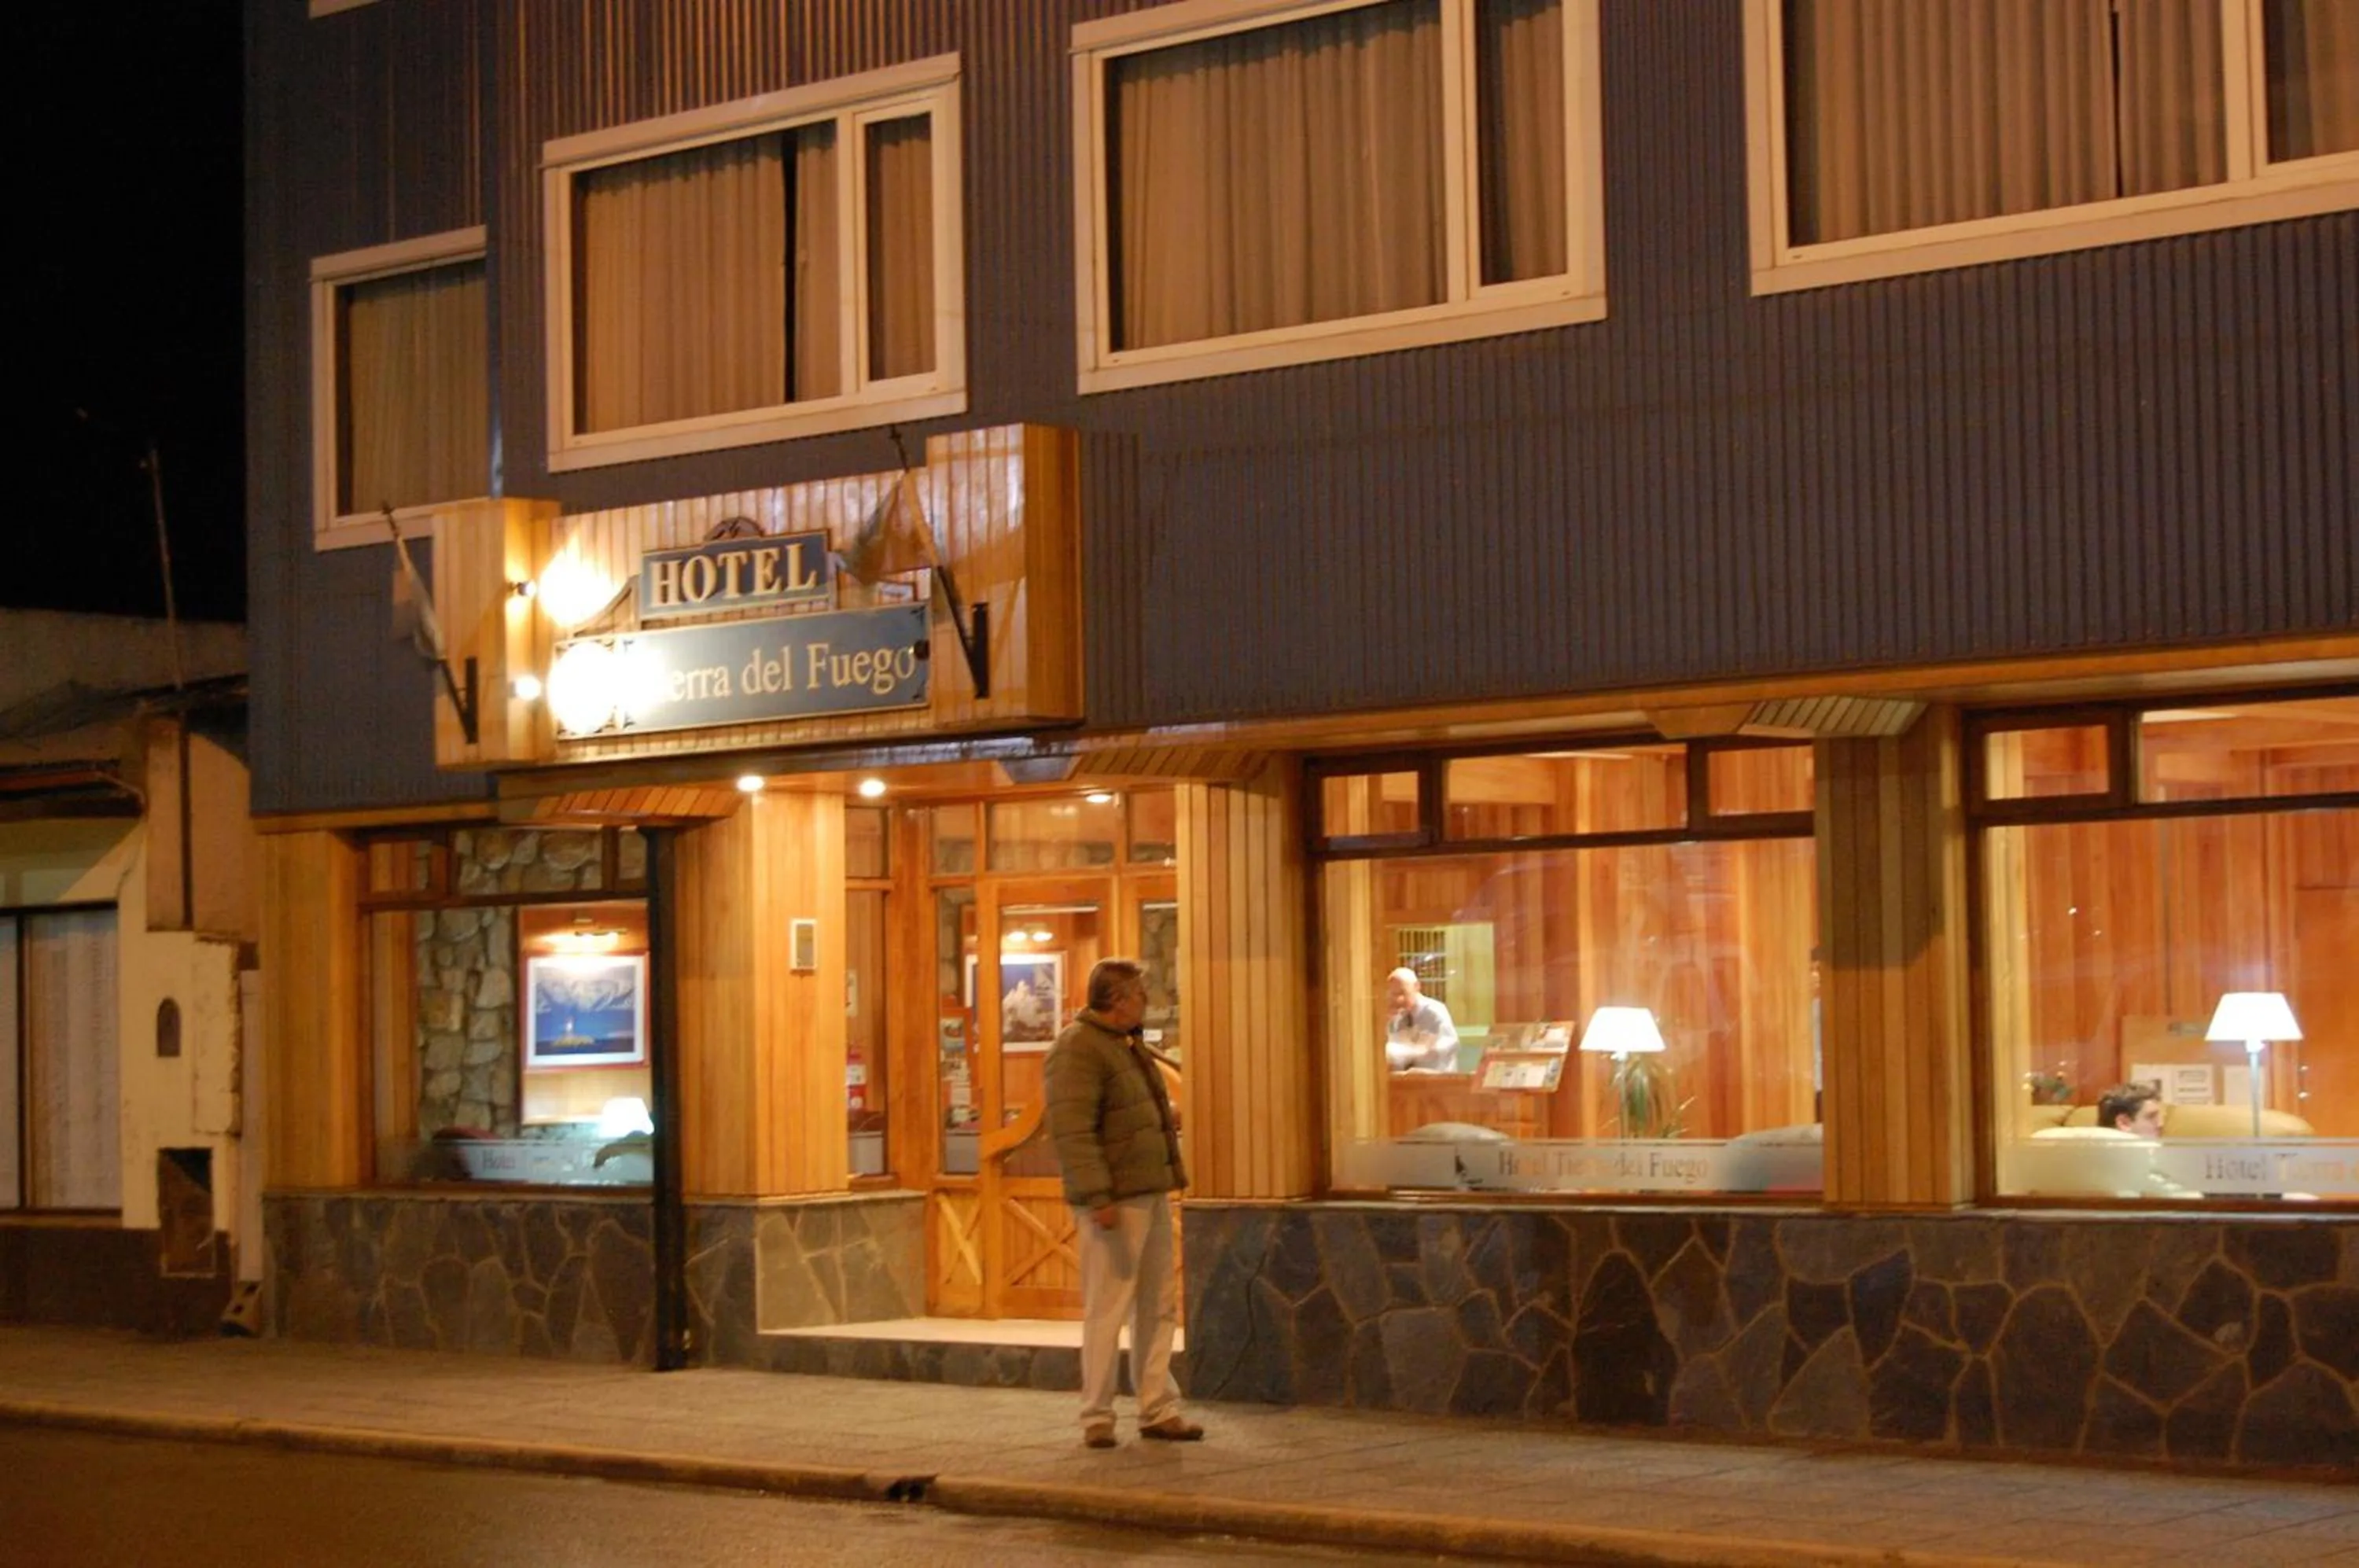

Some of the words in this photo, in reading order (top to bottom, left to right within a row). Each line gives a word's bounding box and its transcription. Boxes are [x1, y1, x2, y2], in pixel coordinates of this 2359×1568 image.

[650, 543, 817, 607] HOTEL
[651, 664, 732, 702] erra
[741, 645, 793, 695] del
[806, 642, 915, 695] Fuego
